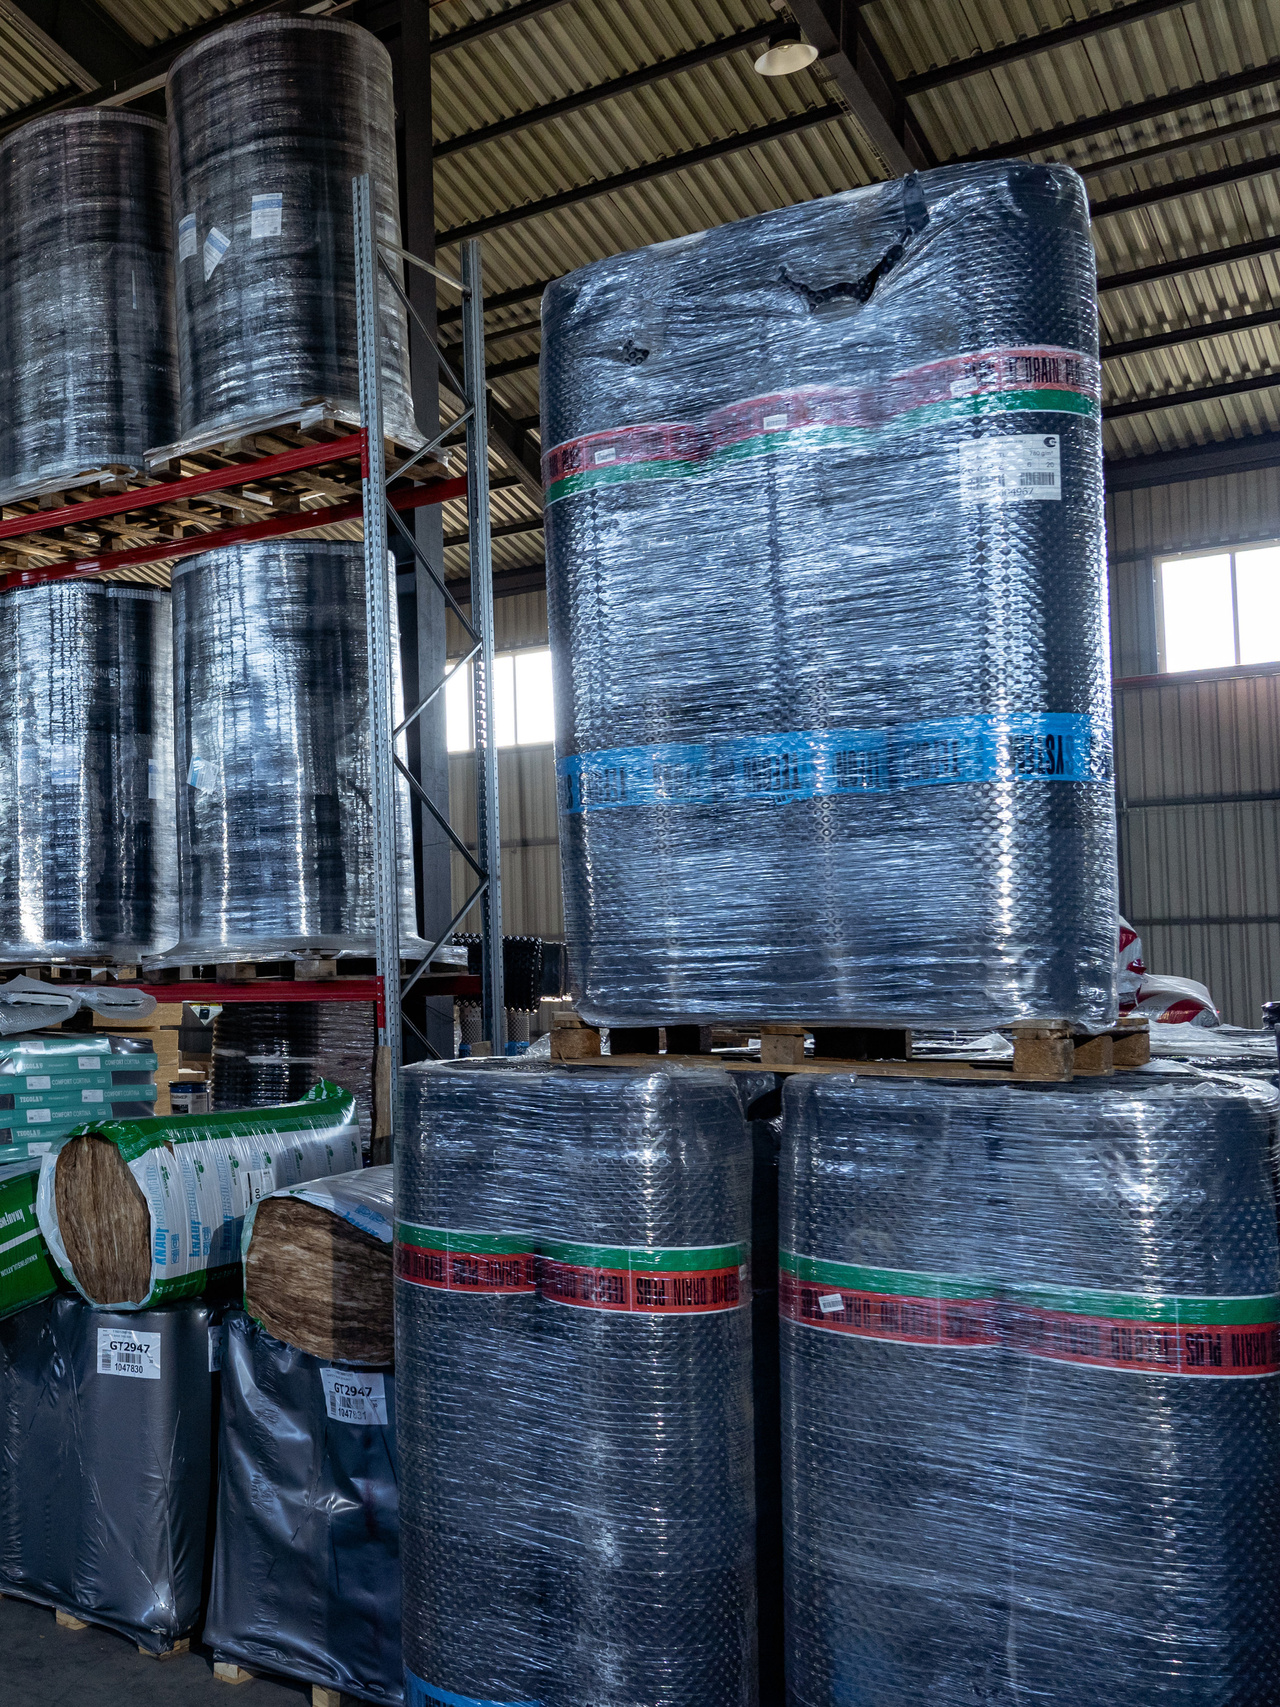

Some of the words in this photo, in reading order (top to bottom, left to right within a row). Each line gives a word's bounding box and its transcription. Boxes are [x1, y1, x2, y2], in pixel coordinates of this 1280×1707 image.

[636, 1278, 666, 1306] PLUS
[673, 1277, 706, 1306] DRAIN
[109, 1340, 151, 1354] GT2947
[1185, 1332, 1222, 1367] PLUS
[114, 1362, 144, 1374] 1047830
[334, 1382, 372, 1397] GT2947
[338, 1407, 367, 1420] 1047831
